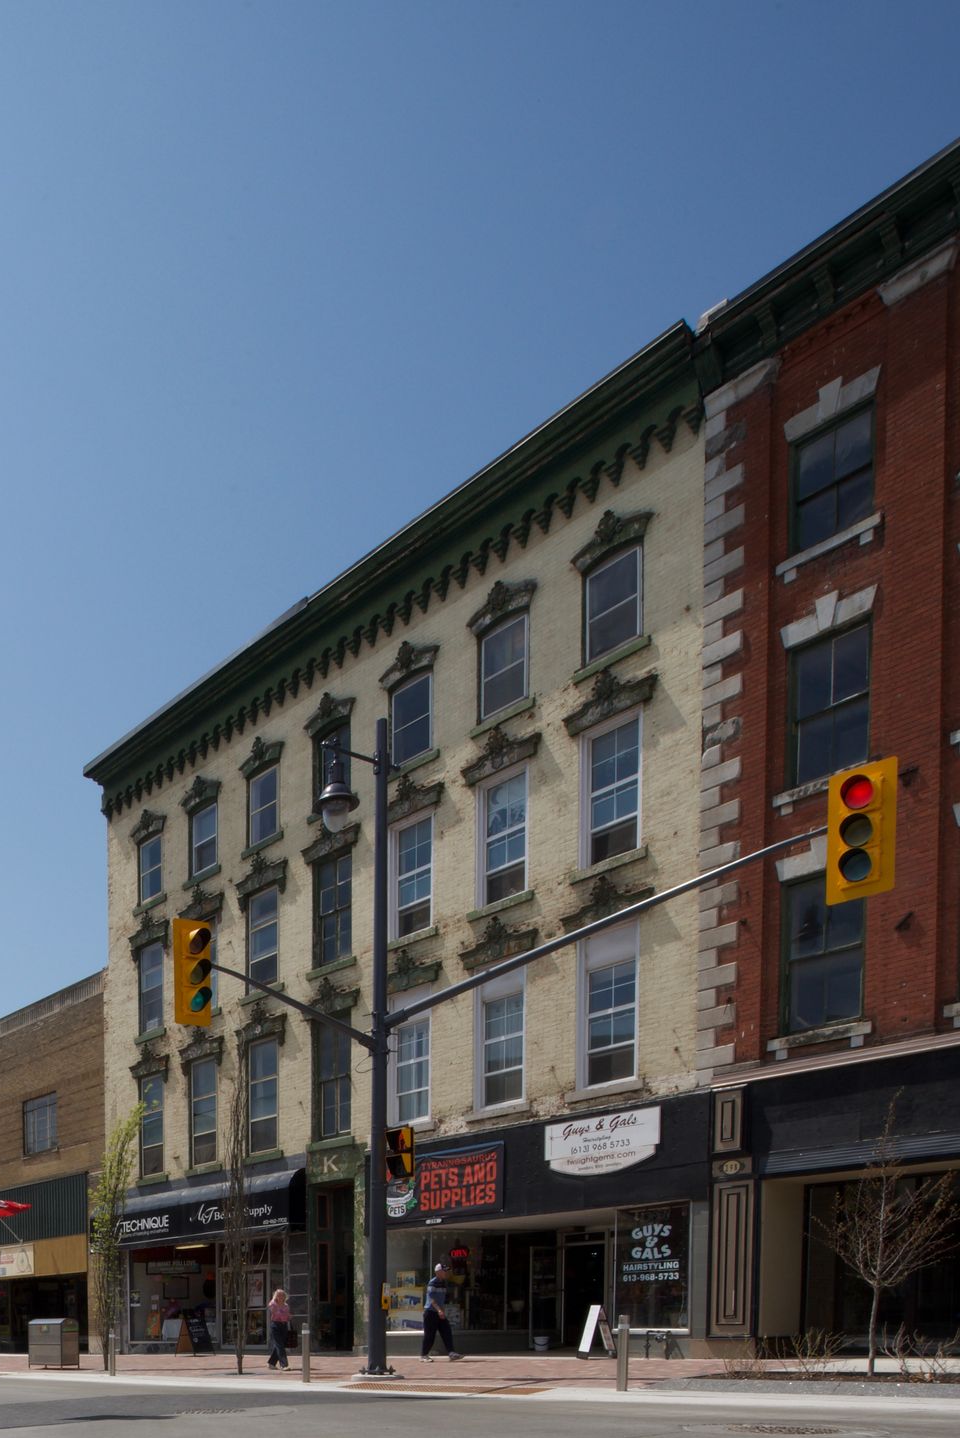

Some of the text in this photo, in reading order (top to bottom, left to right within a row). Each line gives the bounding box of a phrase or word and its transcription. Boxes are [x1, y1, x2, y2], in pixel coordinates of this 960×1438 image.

[562, 1113, 638, 1141] Guys & Gals
[570, 1138, 631, 1155] (613) 968 5733
[420, 1161, 497, 1190] PETS AND
[420, 1183, 496, 1212] SUPPLIES
[243, 1204, 273, 1217] Supply
[389, 1204, 405, 1214] PETS
[120, 1214, 169, 1233] TECHNIQUE
[631, 1223, 672, 1240] GUYS
[645, 1236, 658, 1248] &
[631, 1244, 671, 1260] GALS
[623, 1261, 679, 1272] HAIRSTYLING
[623, 1272, 679, 1282] 613-968-5733
